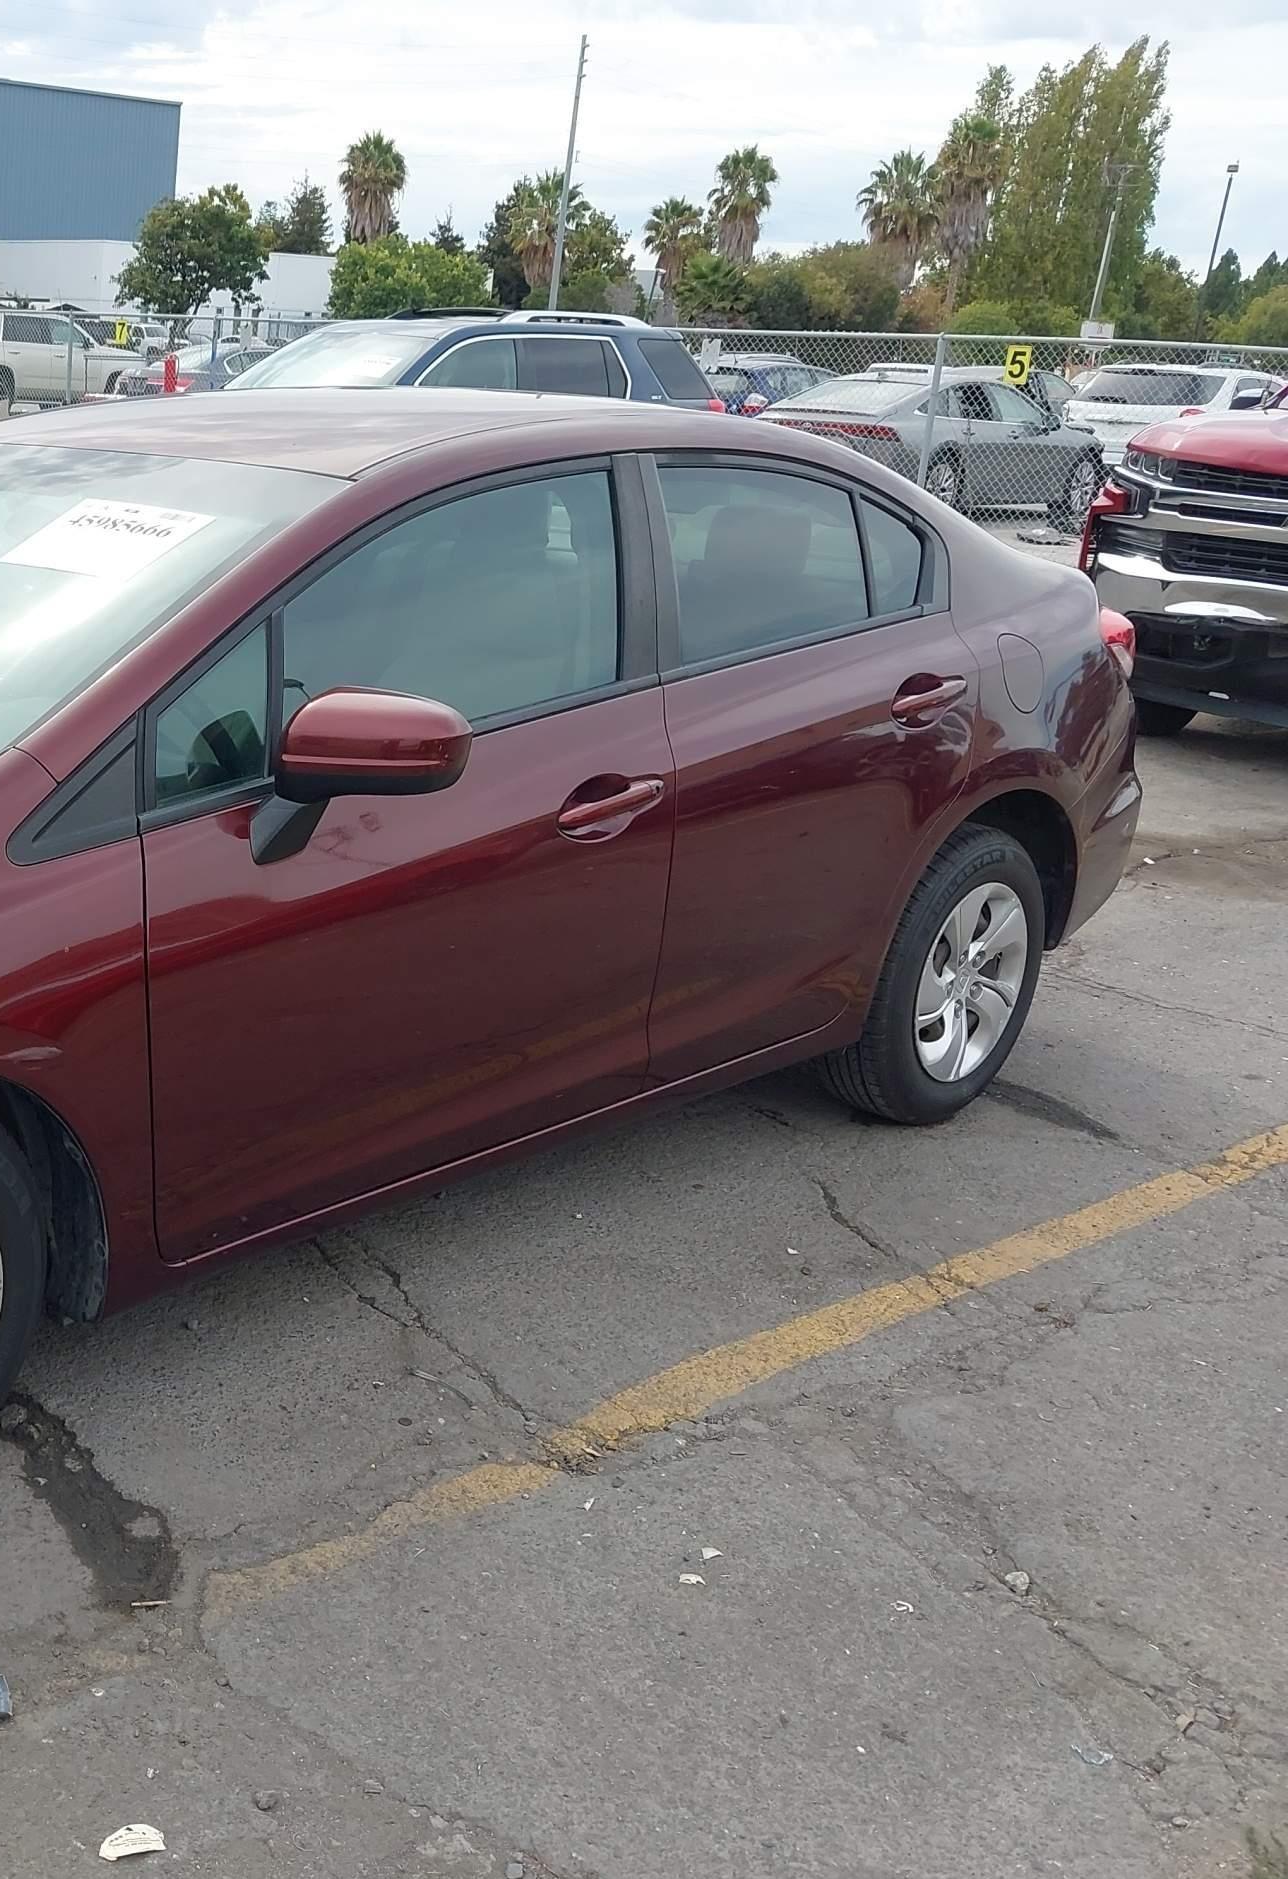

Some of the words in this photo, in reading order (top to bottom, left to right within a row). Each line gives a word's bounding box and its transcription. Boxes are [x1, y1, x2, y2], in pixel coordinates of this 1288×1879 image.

[117, 322, 126, 340] 7
[1008, 351, 1026, 378] 5
[68, 514, 174, 538] 45985666
